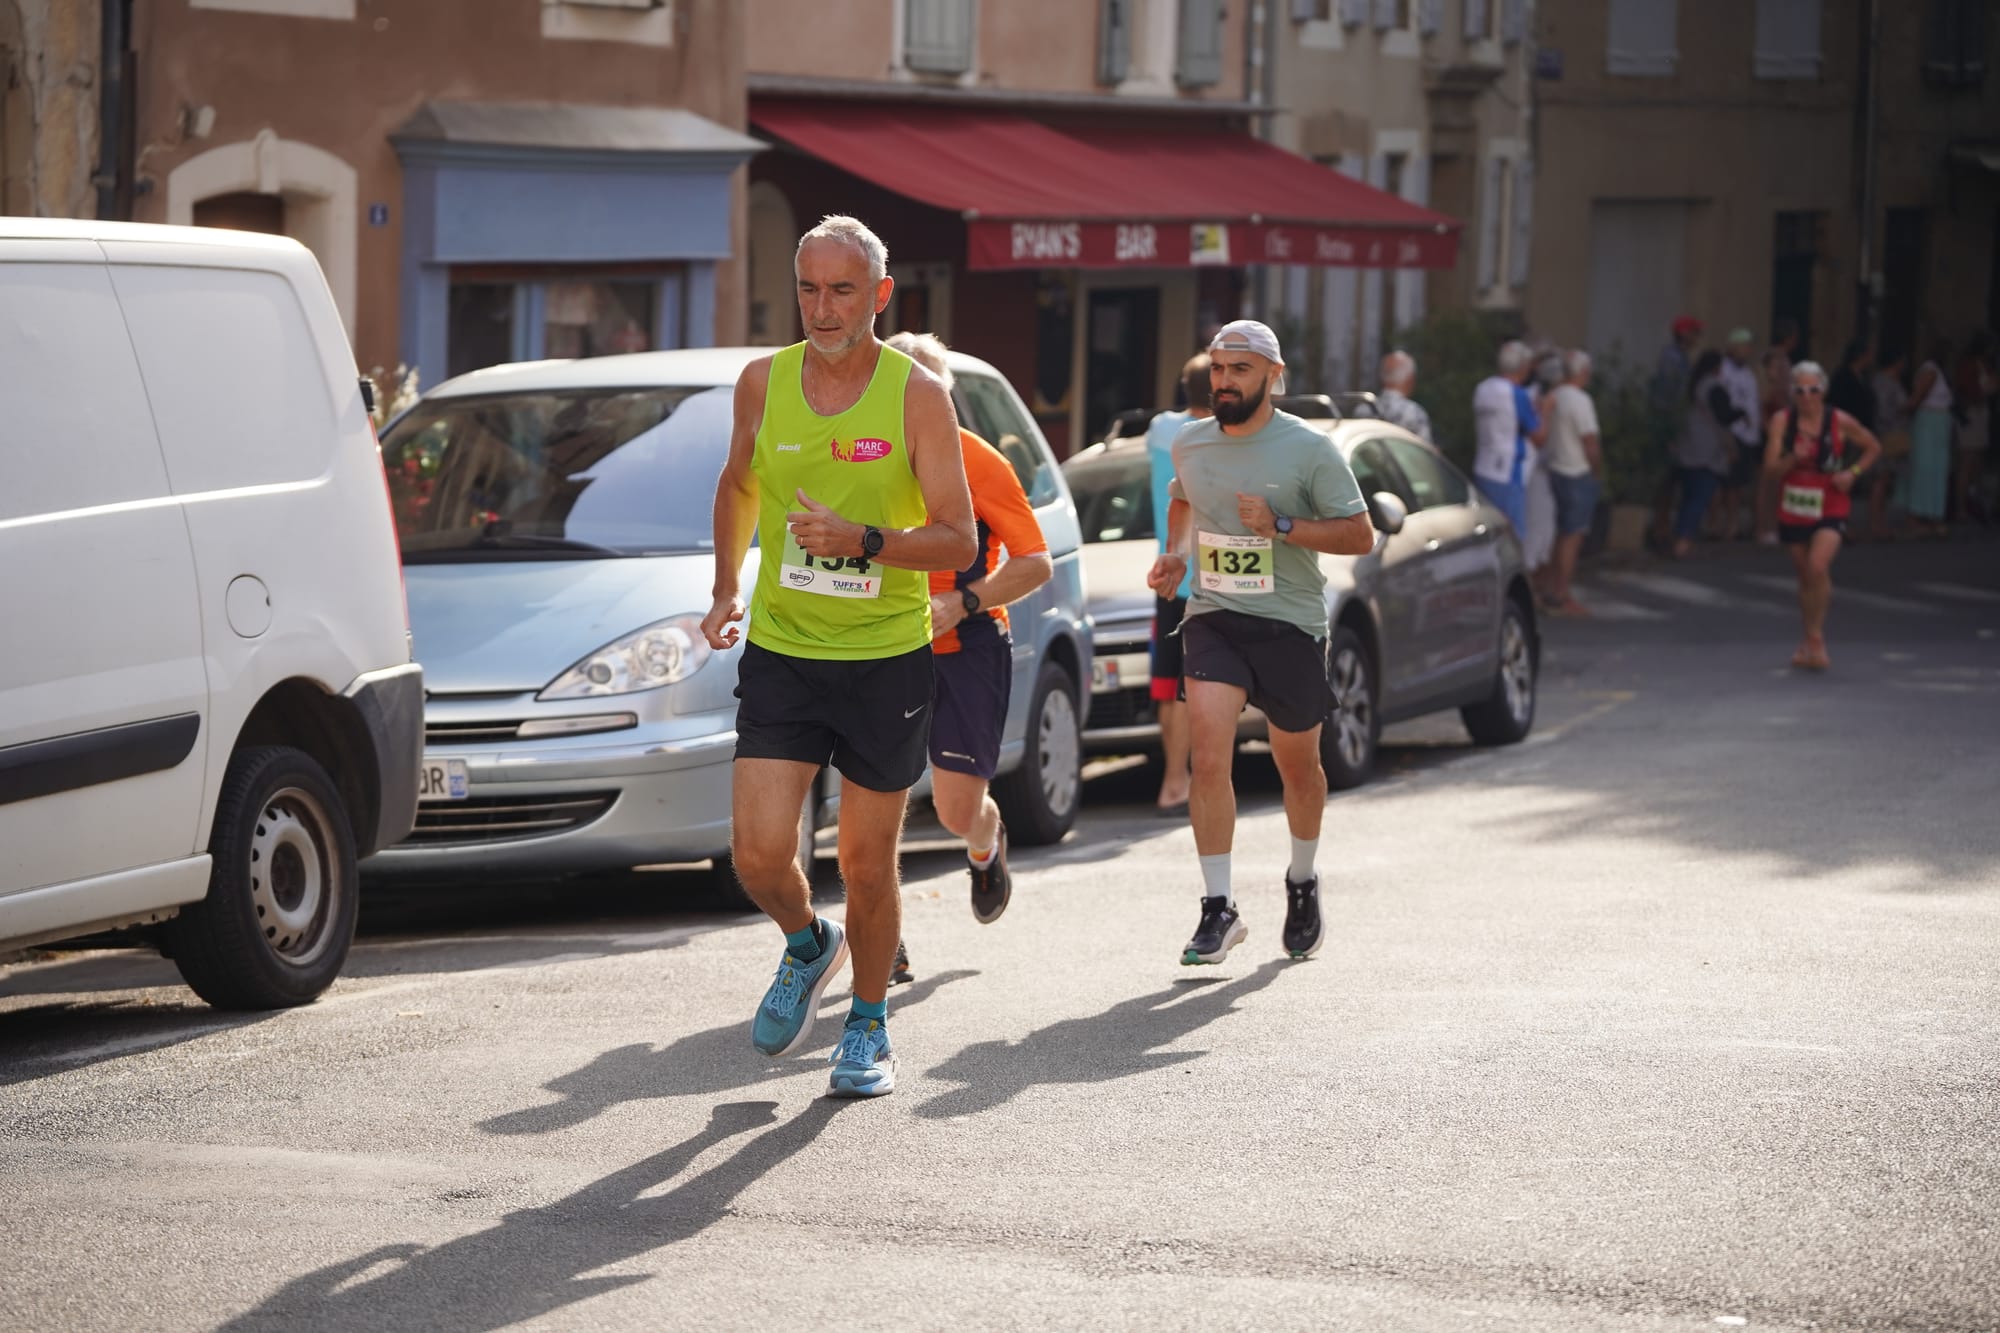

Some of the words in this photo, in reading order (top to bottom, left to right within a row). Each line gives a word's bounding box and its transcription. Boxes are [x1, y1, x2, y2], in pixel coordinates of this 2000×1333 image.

[1011, 223, 1081, 259] RYAN'S
[1115, 224, 1158, 260] BAR
[856, 441, 883, 451] MARC
[1208, 549, 1261, 574] 132
[832, 580, 862, 589] TUFF'S
